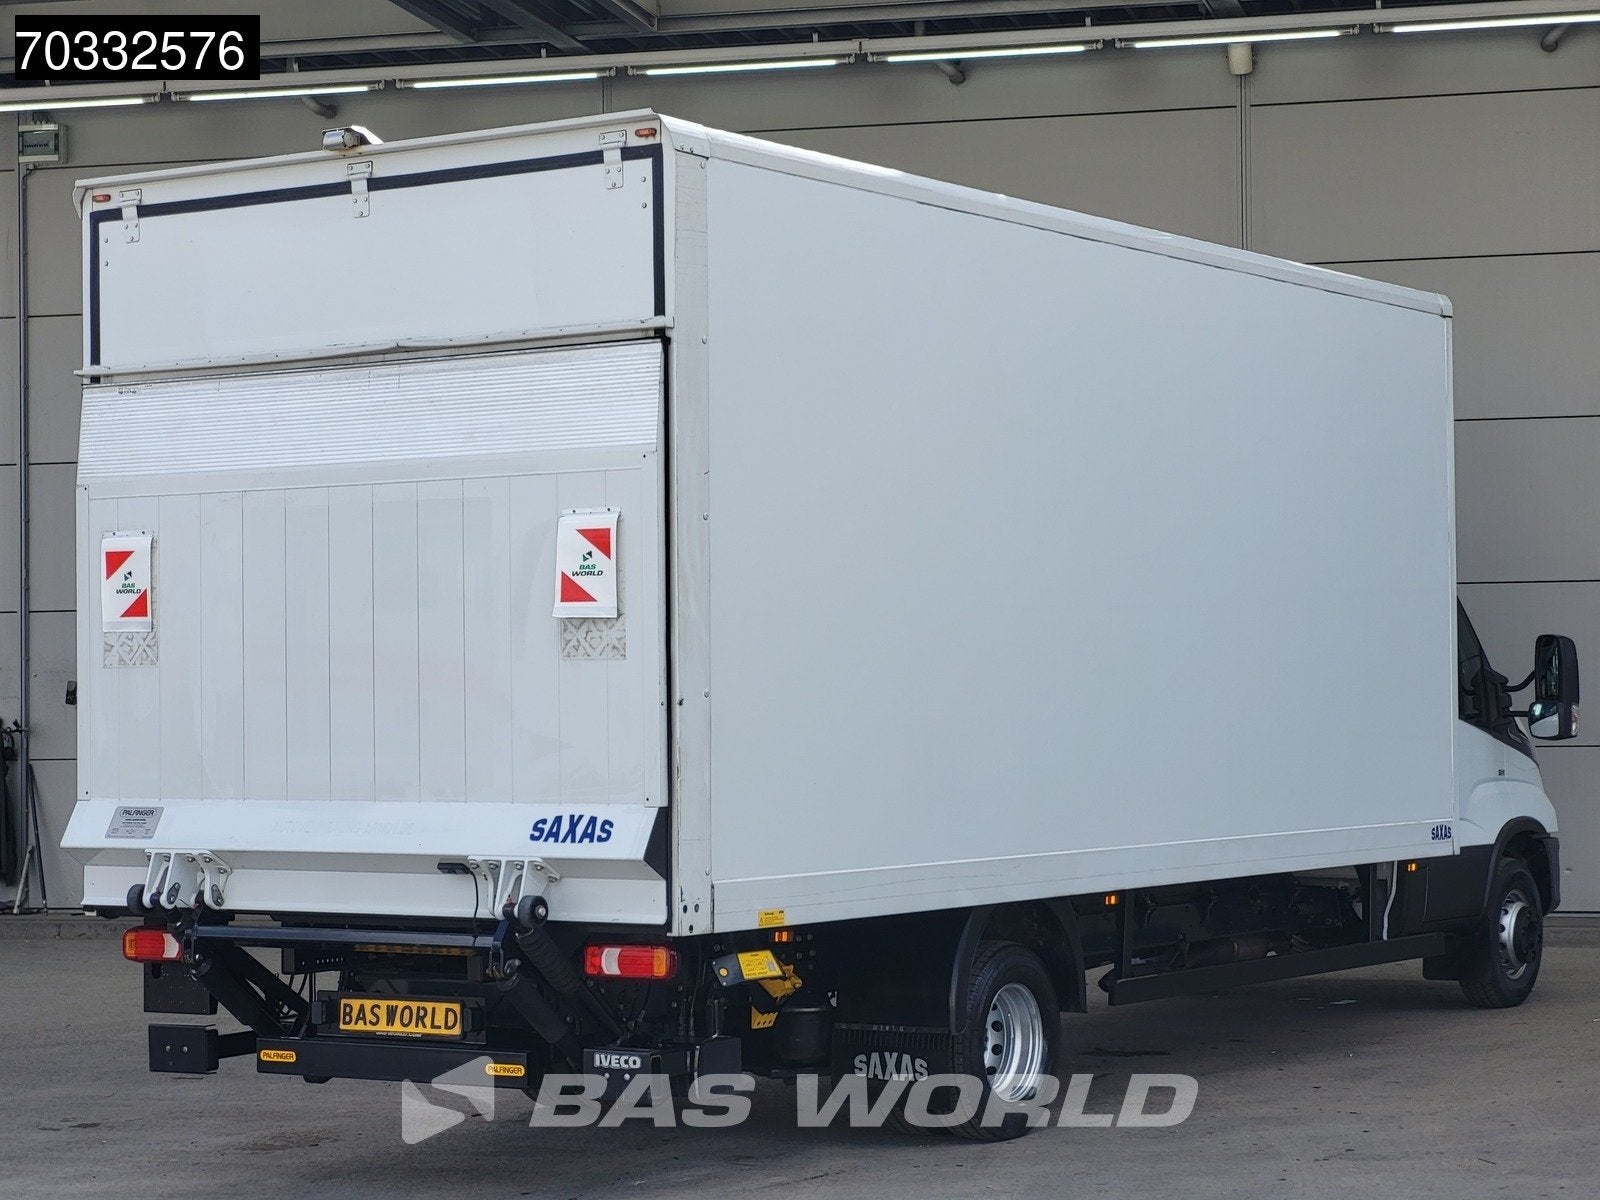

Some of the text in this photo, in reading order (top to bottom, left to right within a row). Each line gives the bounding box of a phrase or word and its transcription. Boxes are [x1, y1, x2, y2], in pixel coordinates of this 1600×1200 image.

[529, 814, 614, 844] SAXAS
[1431, 824, 1452, 841] SAXAS
[342, 1003, 459, 1031] BAS WORLD
[262, 1051, 295, 1060] PALFINGER
[593, 1052, 641, 1069] IVECO
[488, 1065, 523, 1075] PALFINGER
[853, 1051, 929, 1082] SAXAS
